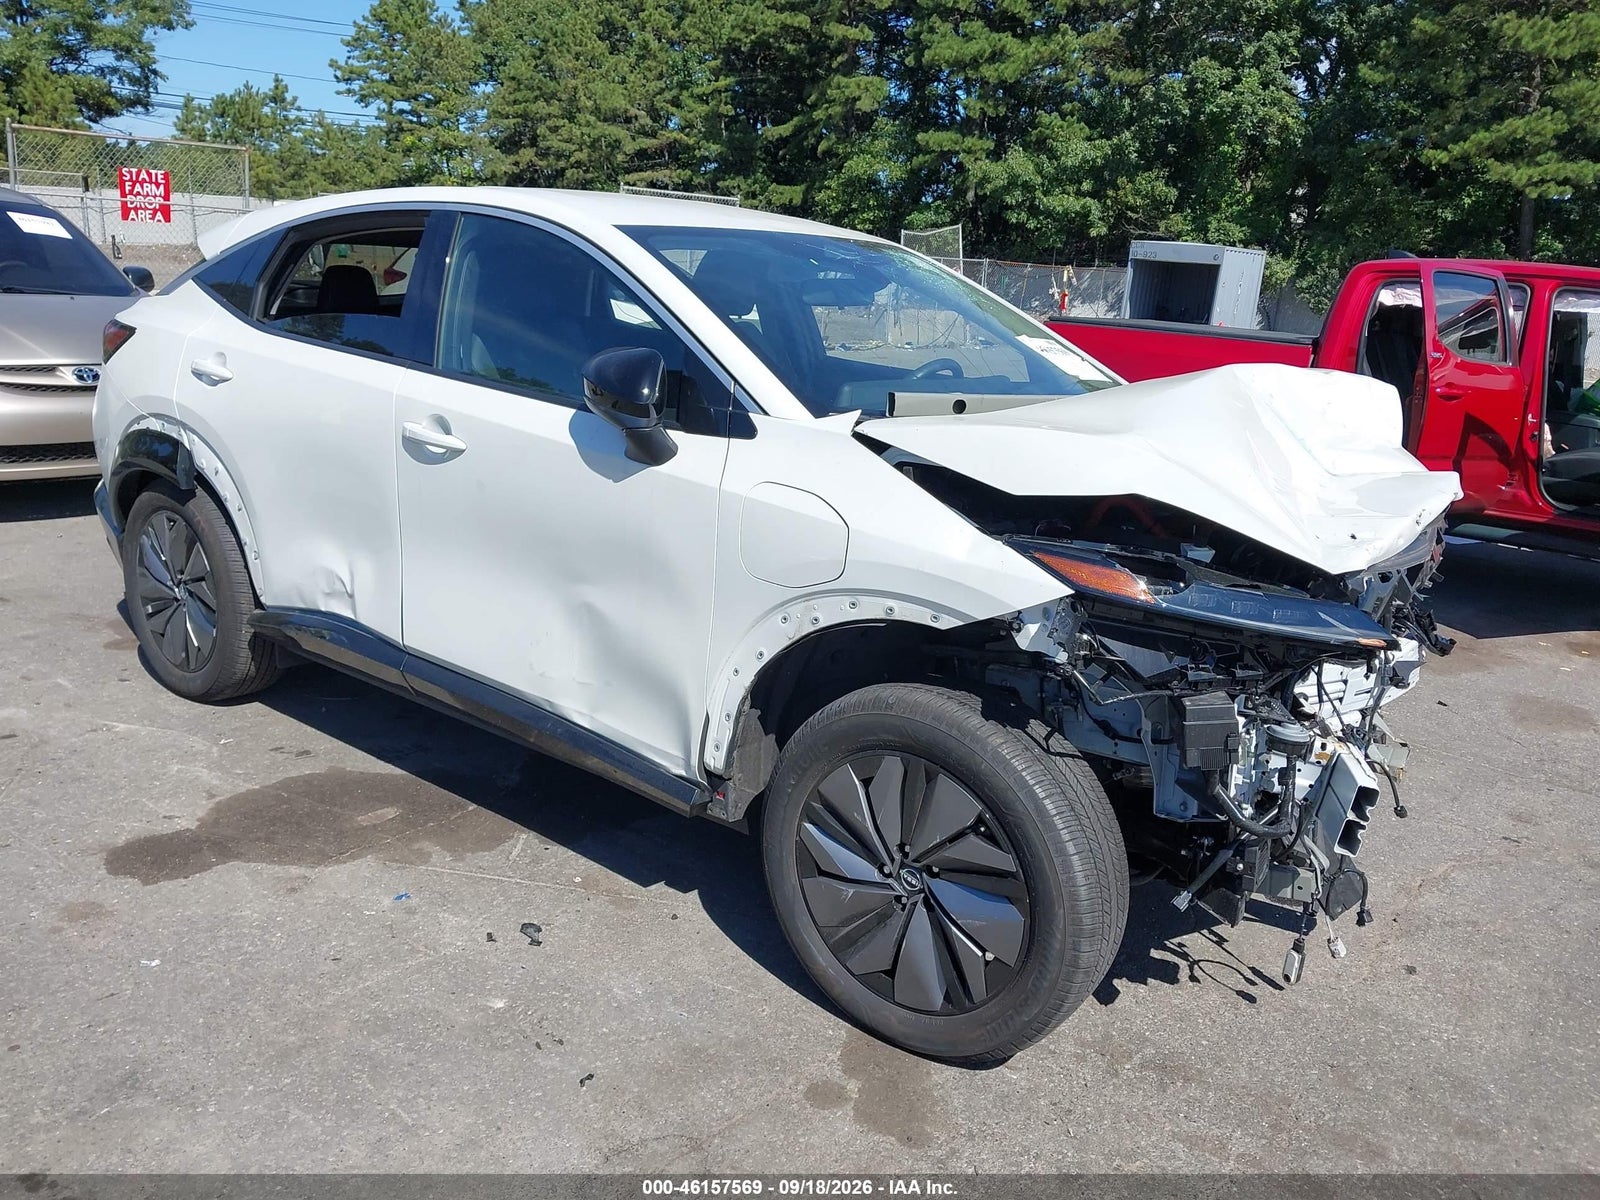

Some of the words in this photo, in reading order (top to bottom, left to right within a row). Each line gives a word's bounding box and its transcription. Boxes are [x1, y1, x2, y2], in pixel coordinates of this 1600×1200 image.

[122, 168, 165, 183] STATE
[125, 182, 164, 196] FARM
[127, 195, 164, 209] DROP
[128, 209, 165, 223] AREA
